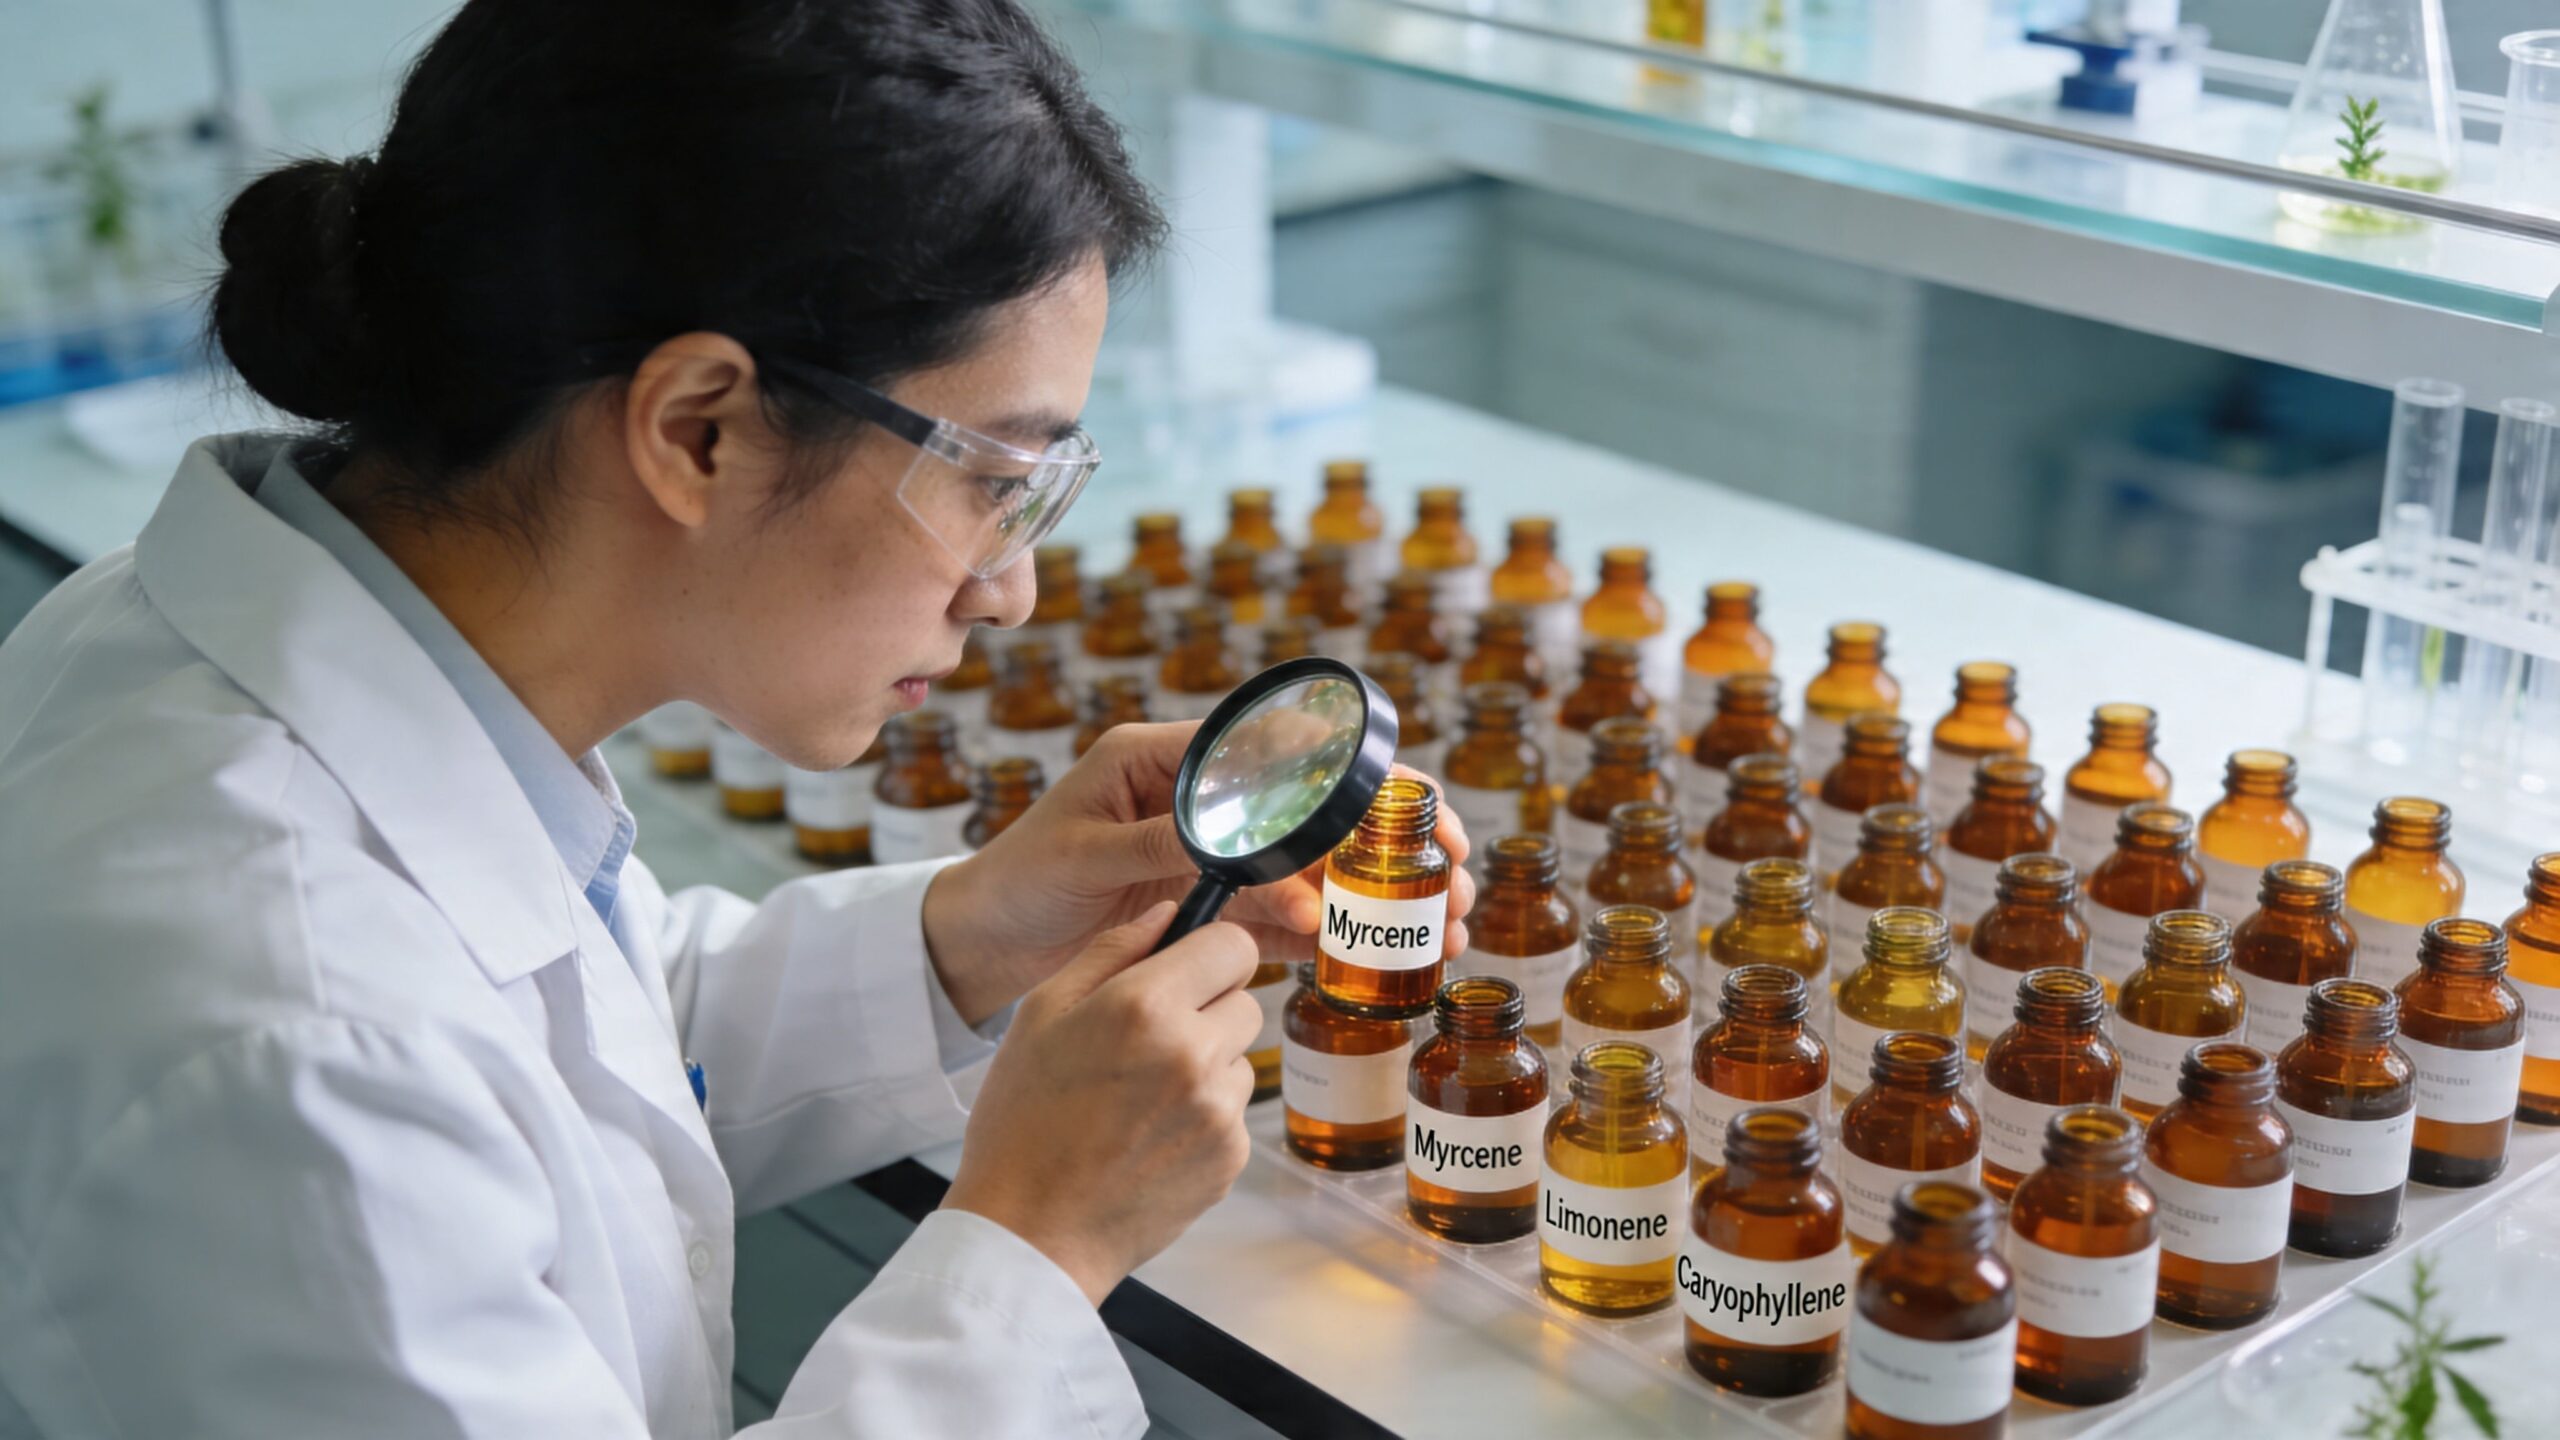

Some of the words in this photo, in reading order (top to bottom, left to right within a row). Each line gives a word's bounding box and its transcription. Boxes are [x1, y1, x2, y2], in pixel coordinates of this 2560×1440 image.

[1328, 903, 1430, 950] Myrcene
[1415, 1123, 1523, 1172] Myrcene
[1546, 1189, 1668, 1241] Limonene
[1677, 1255, 1846, 1327] Caryophyllene
